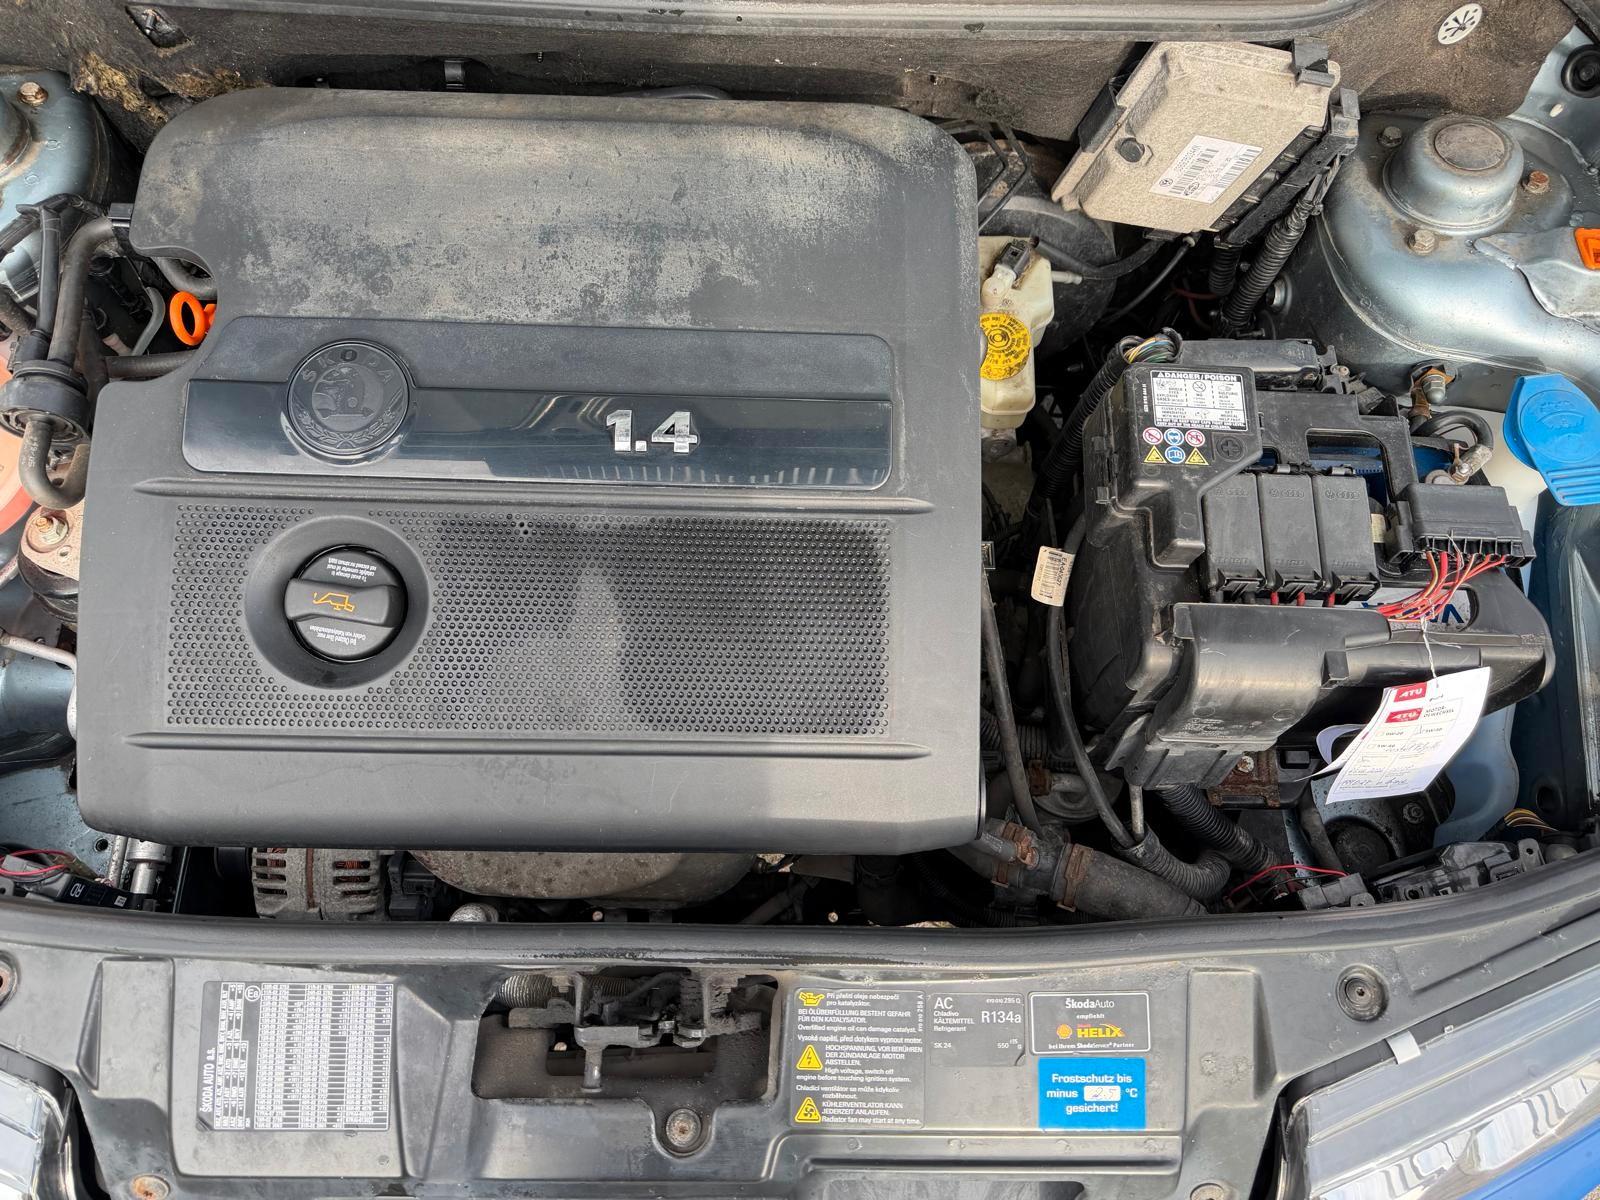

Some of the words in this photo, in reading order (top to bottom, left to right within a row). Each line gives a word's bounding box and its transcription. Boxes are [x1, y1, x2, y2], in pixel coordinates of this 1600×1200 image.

[606, 410, 698, 452] 1.4
[1400, 688, 1422, 698] ATU
[934, 997, 952, 1009] AC
[1065, 998, 1114, 1009] ŠkodaAuto
[981, 1011, 1021, 1023] R134a
[1077, 1027, 1124, 1038] HELIX
[206, 1048, 215, 1060] a.s.
[203, 1064, 214, 1084] AUTO
[1052, 1074, 1115, 1083] Frostschutz
[1116, 1074, 1132, 1083] bis
[200, 1086, 213, 1112] ŠKODA
[1046, 1088, 1078, 1098] minus
[1126, 1088, 1138, 1098] °C
[1066, 1102, 1119, 1115] gesichert!
